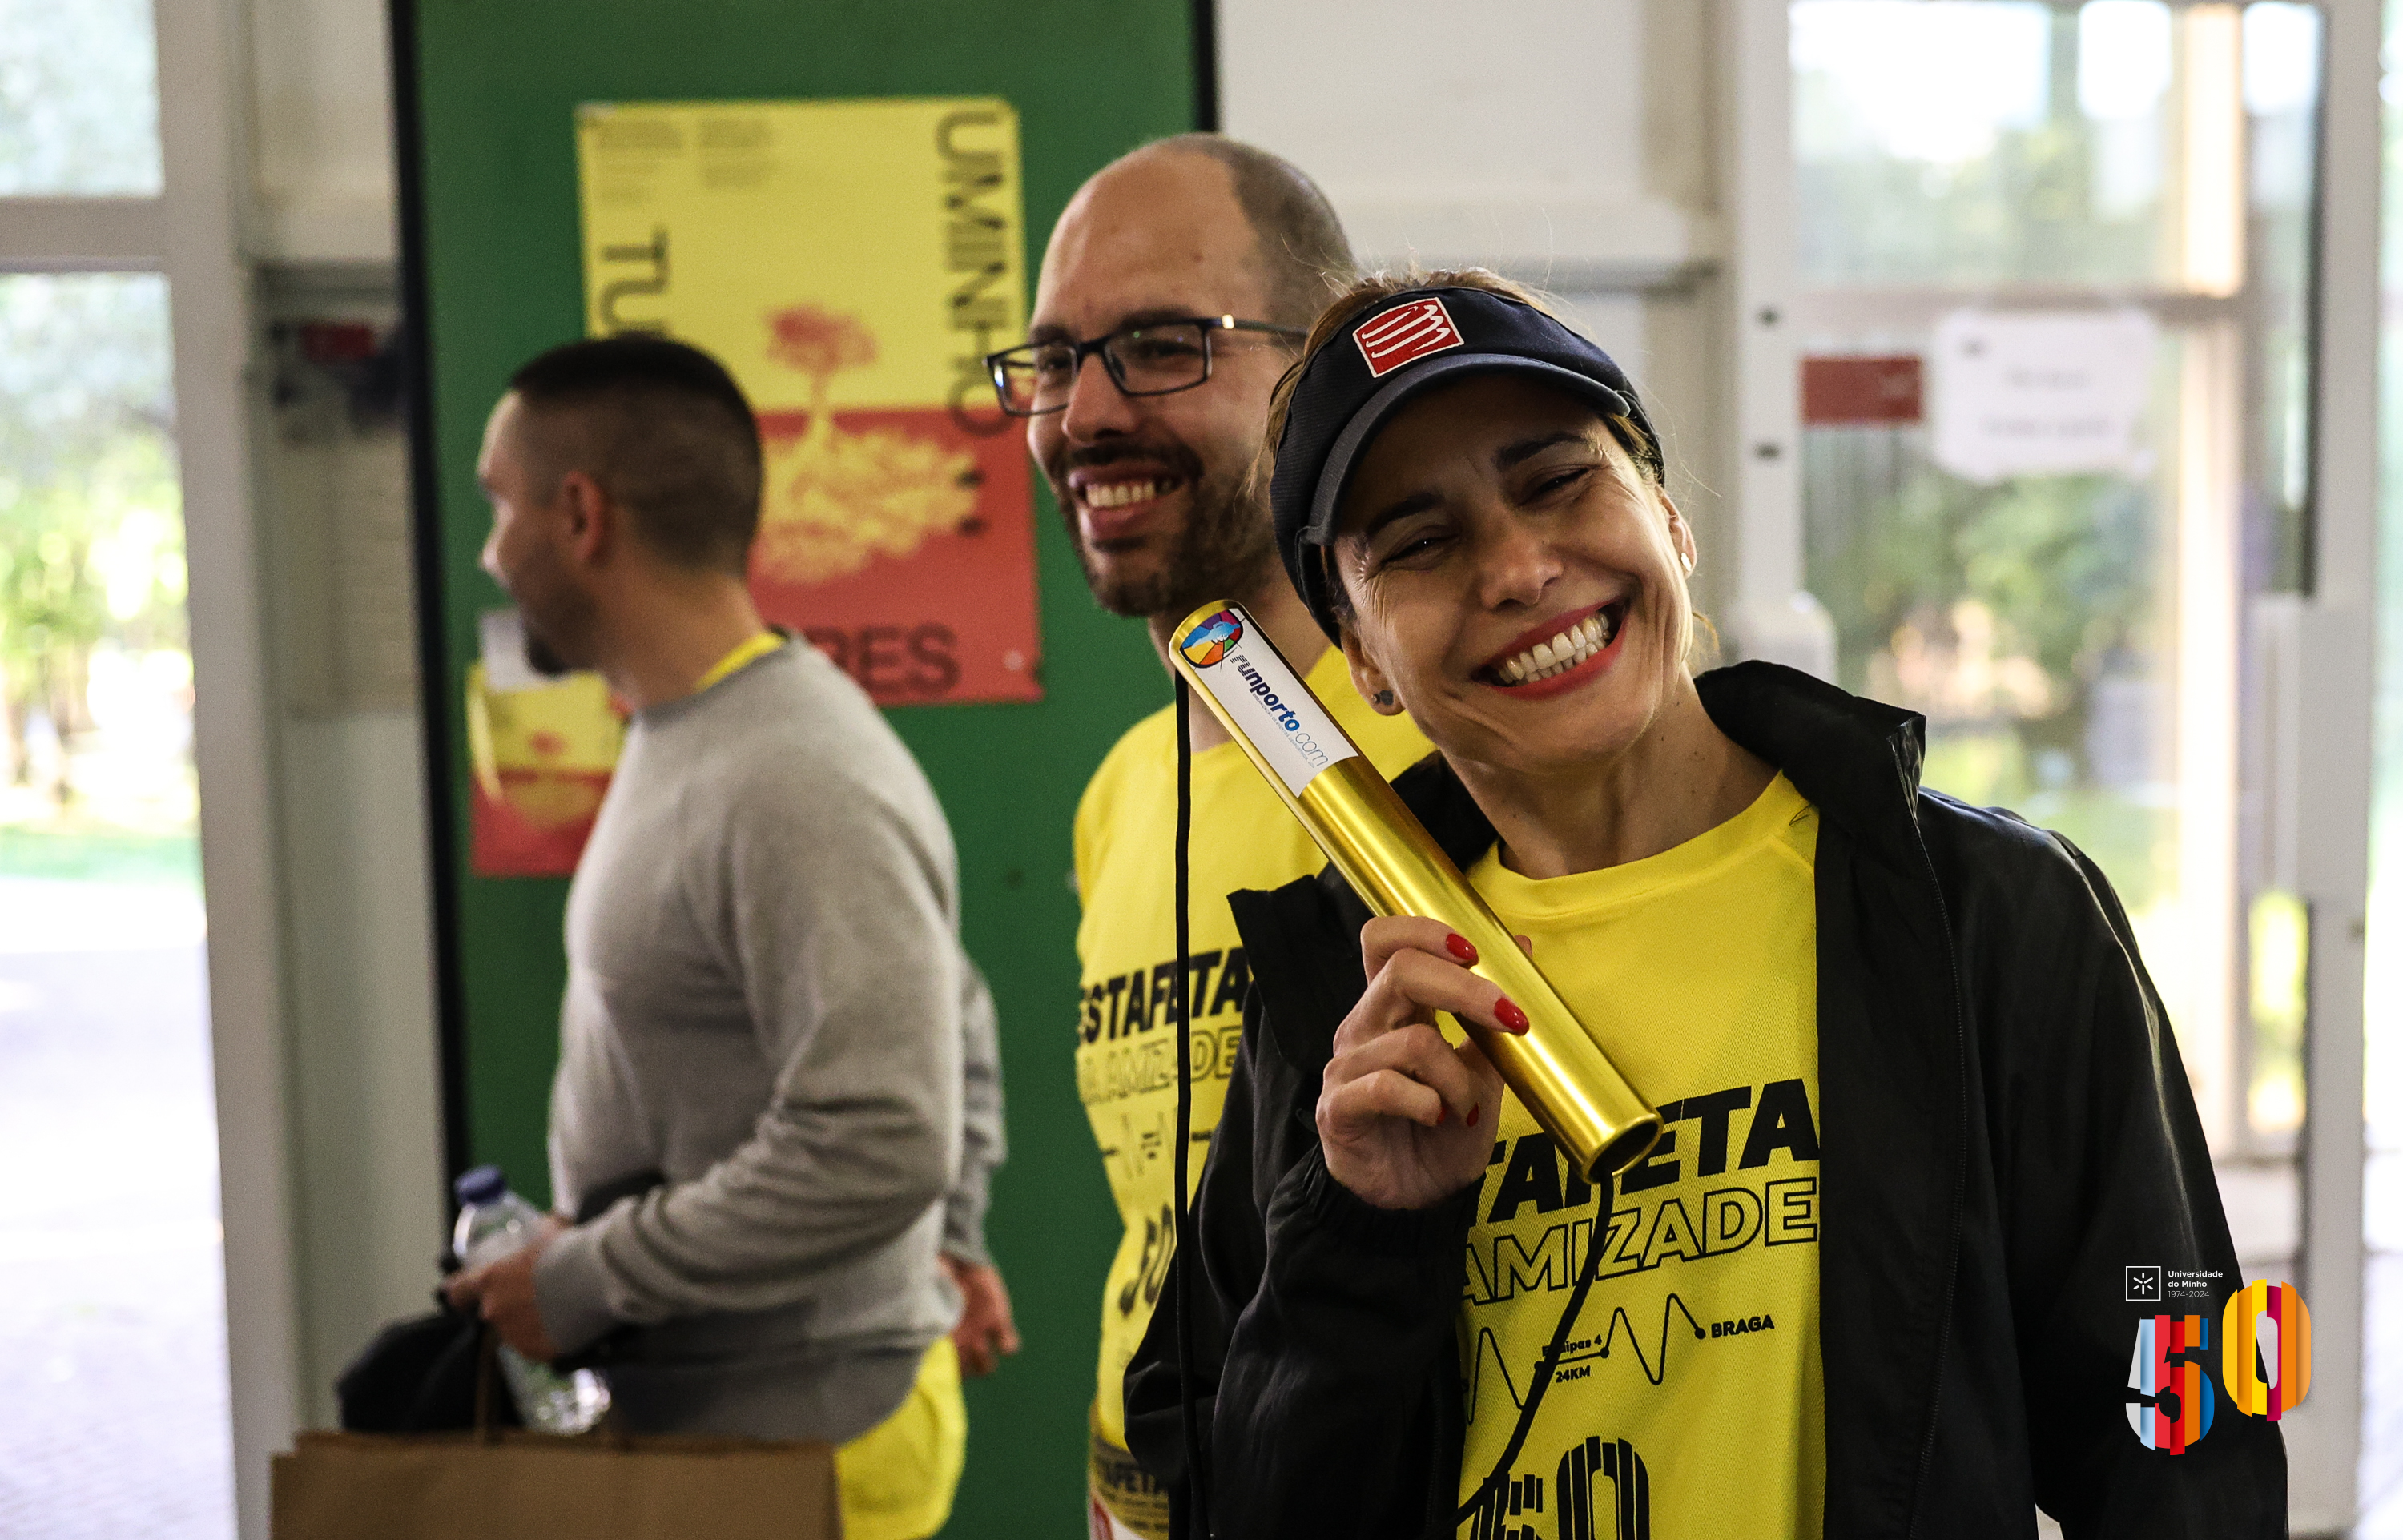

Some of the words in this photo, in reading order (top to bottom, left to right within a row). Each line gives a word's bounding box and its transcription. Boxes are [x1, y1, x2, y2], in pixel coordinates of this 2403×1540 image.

[1230, 653, 1330, 767] runporto.com
[1105, 1024, 1242, 1102] AMIZDE
[1711, 1315, 1775, 1338] BRAGA
[1594, 1333, 1603, 1345] 4
[1556, 1365, 1592, 1383] 24KM
